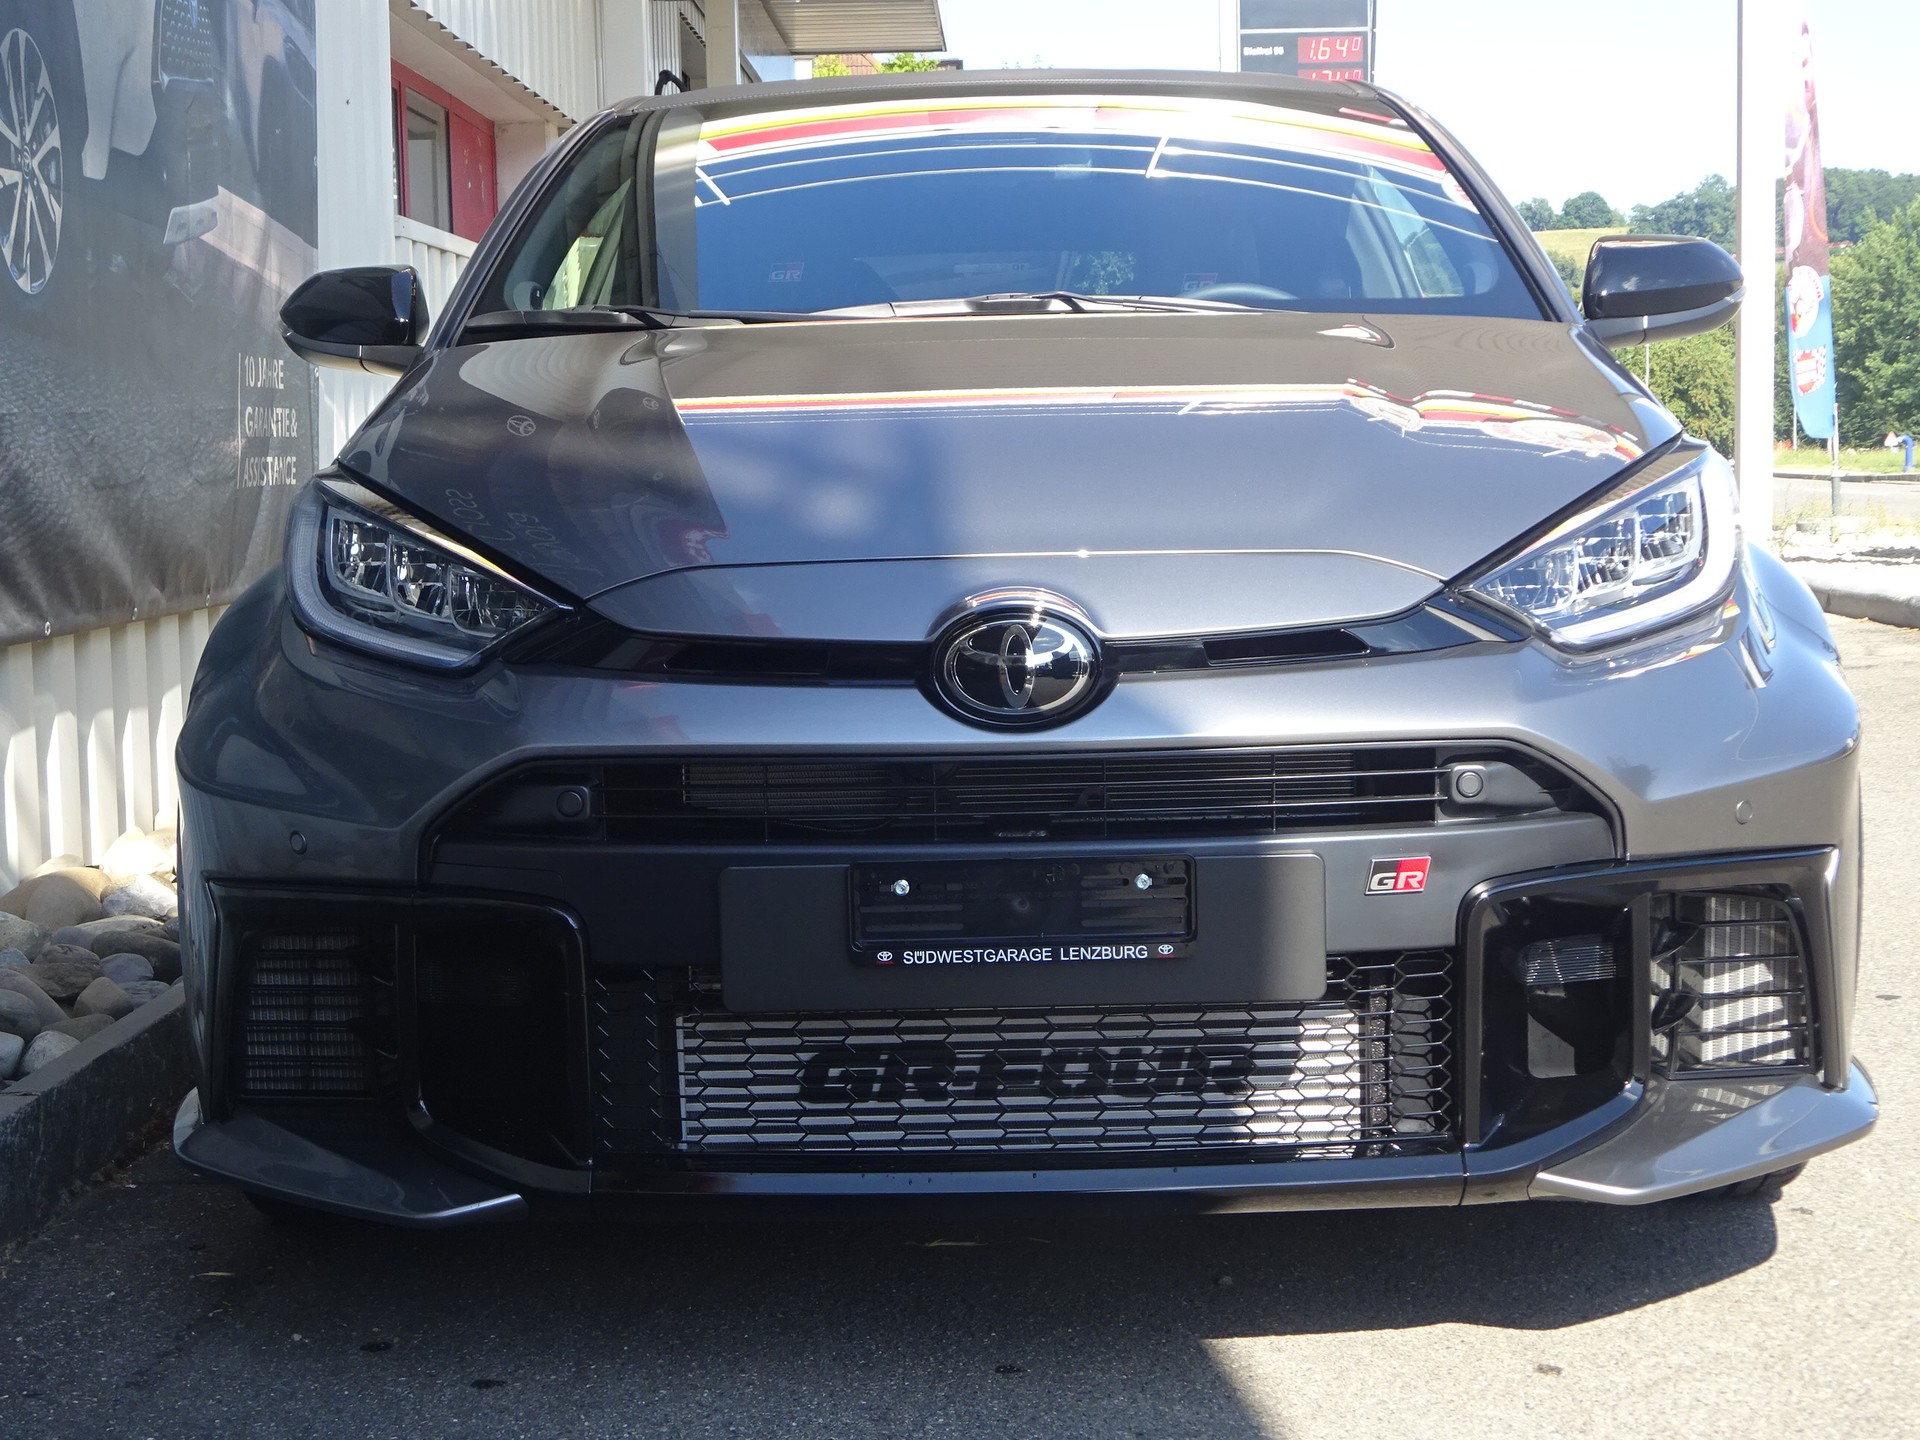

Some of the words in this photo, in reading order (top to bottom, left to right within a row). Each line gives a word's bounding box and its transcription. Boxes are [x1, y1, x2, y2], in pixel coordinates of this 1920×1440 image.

[244, 356, 255, 387] 10
[257, 357, 284, 389] JAHRE
[242, 456, 296, 488] ASSISTANCE
[1370, 871, 1424, 890] GR
[903, 947, 1052, 965] SÜDWESTGARAGE
[1060, 945, 1148, 961] LENZBURG
